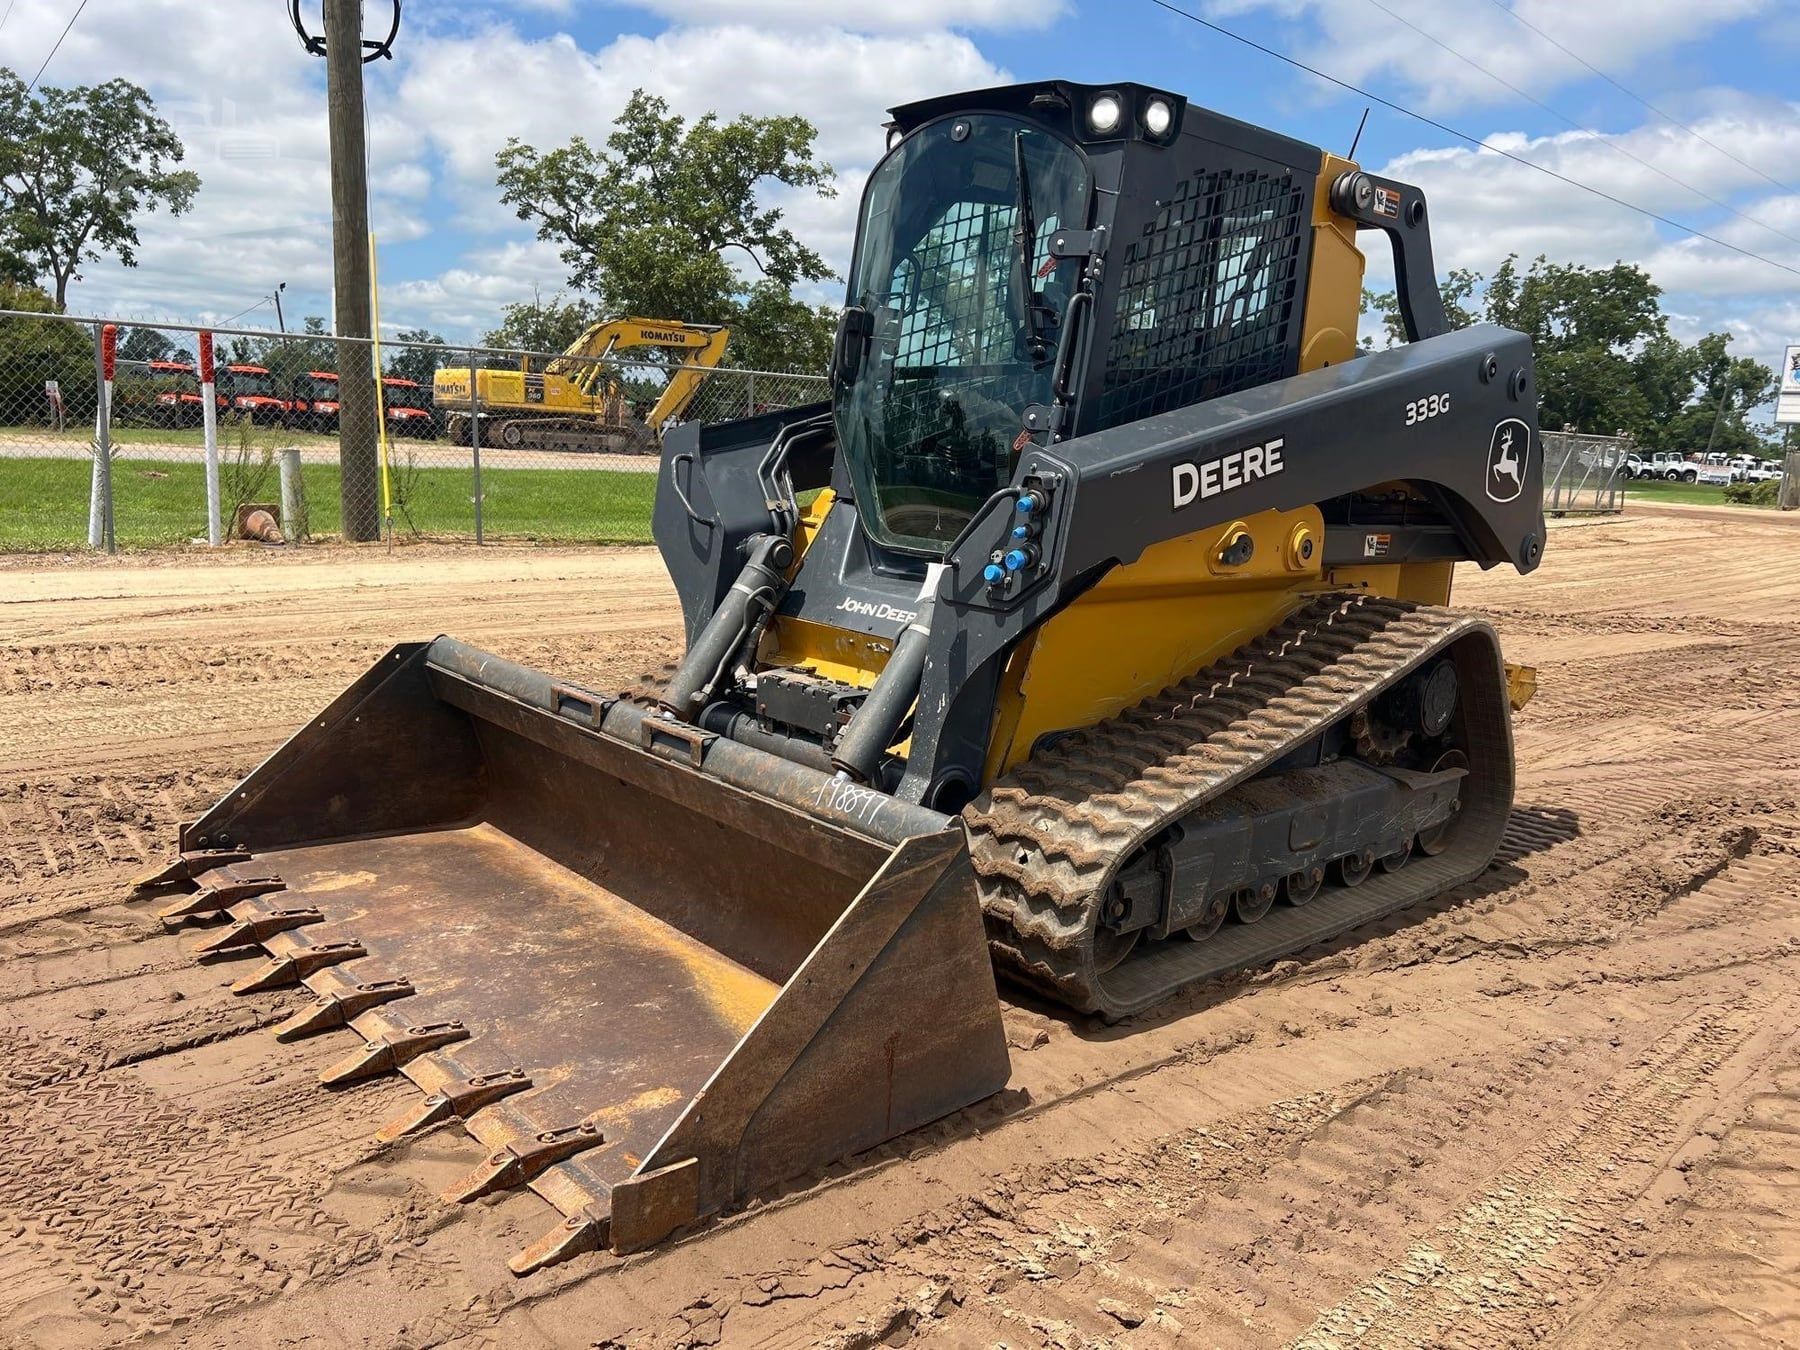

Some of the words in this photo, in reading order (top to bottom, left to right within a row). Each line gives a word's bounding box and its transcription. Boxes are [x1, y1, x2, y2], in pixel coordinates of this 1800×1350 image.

[640, 330, 686, 343] KOMATSU
[1405, 393, 1450, 426] 333G
[1172, 438, 1284, 509] DEERE
[836, 597, 878, 617] JOHN
[875, 603, 917, 623] DEER
[815, 777, 890, 825] 198897
